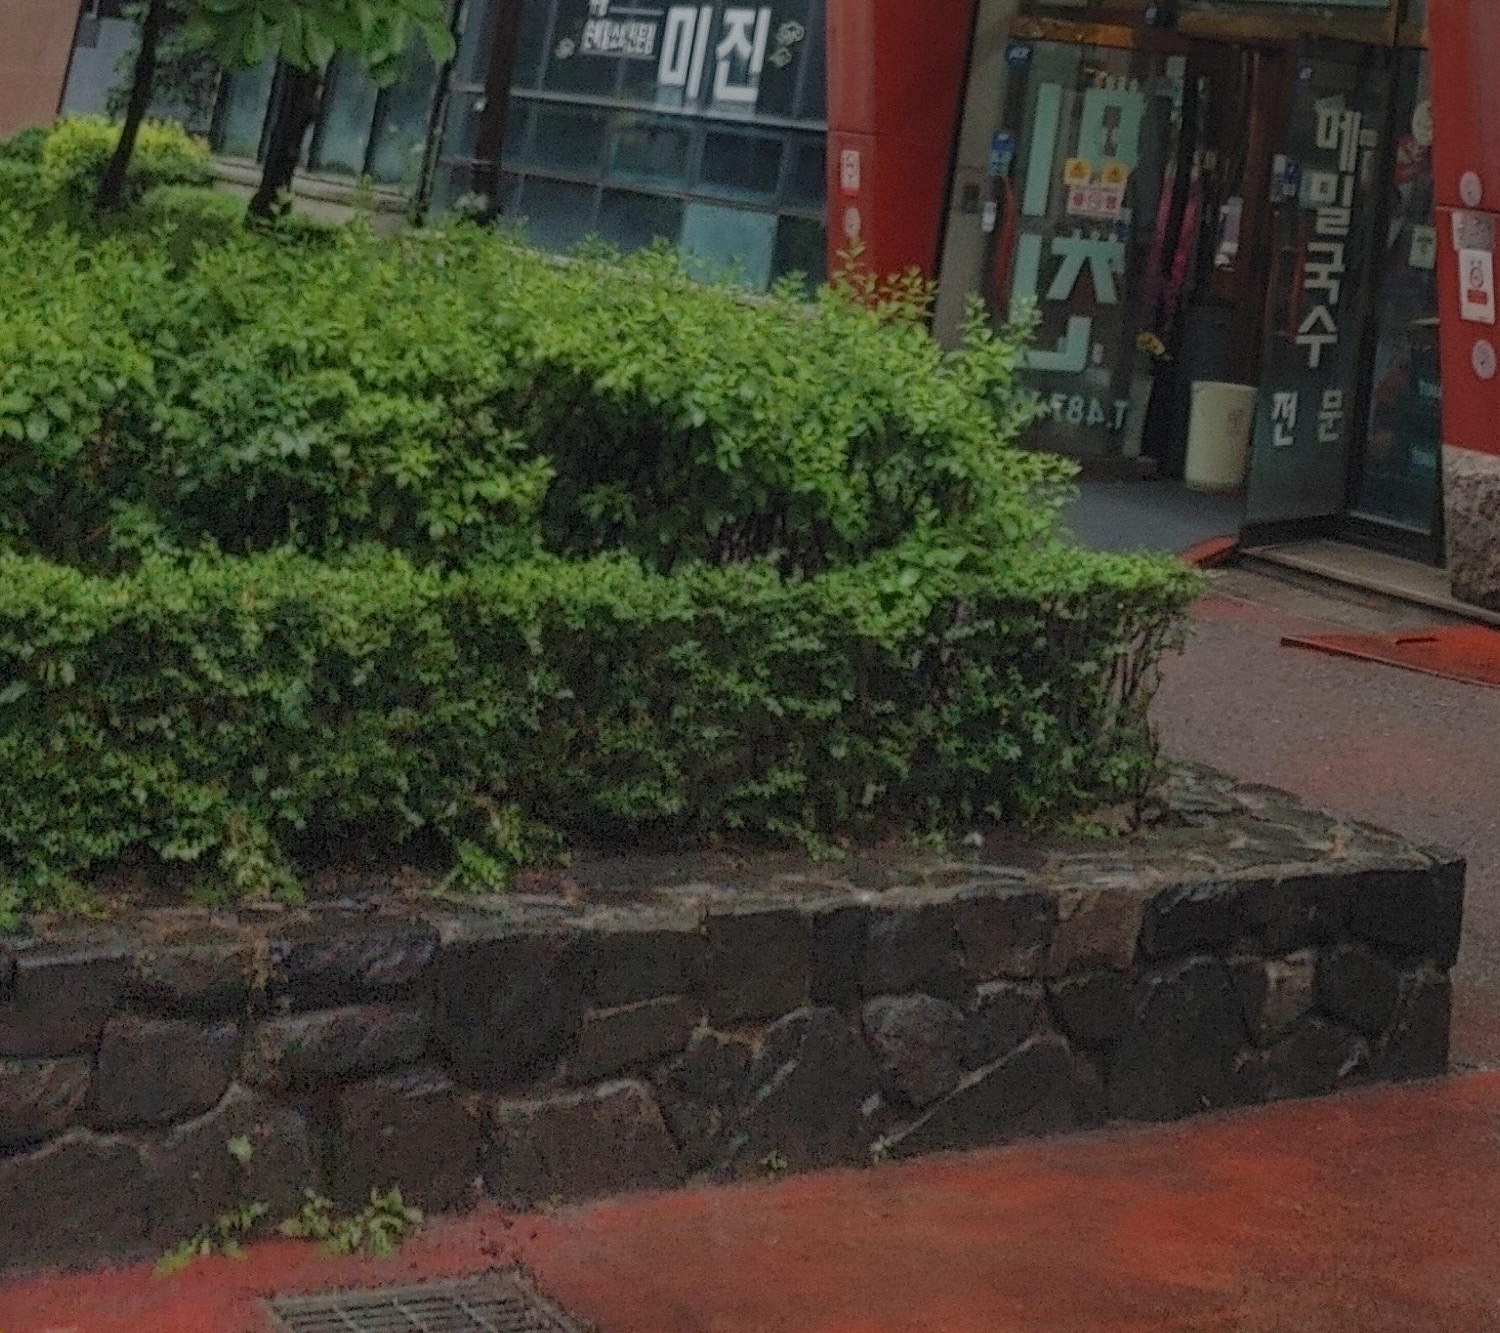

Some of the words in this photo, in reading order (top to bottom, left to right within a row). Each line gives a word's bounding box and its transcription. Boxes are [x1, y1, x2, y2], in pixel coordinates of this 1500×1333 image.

[657, 5, 772, 104] 미진
[1296, 109, 1362, 369] 메밀국수
[1272, 389, 1344, 447] 전문
